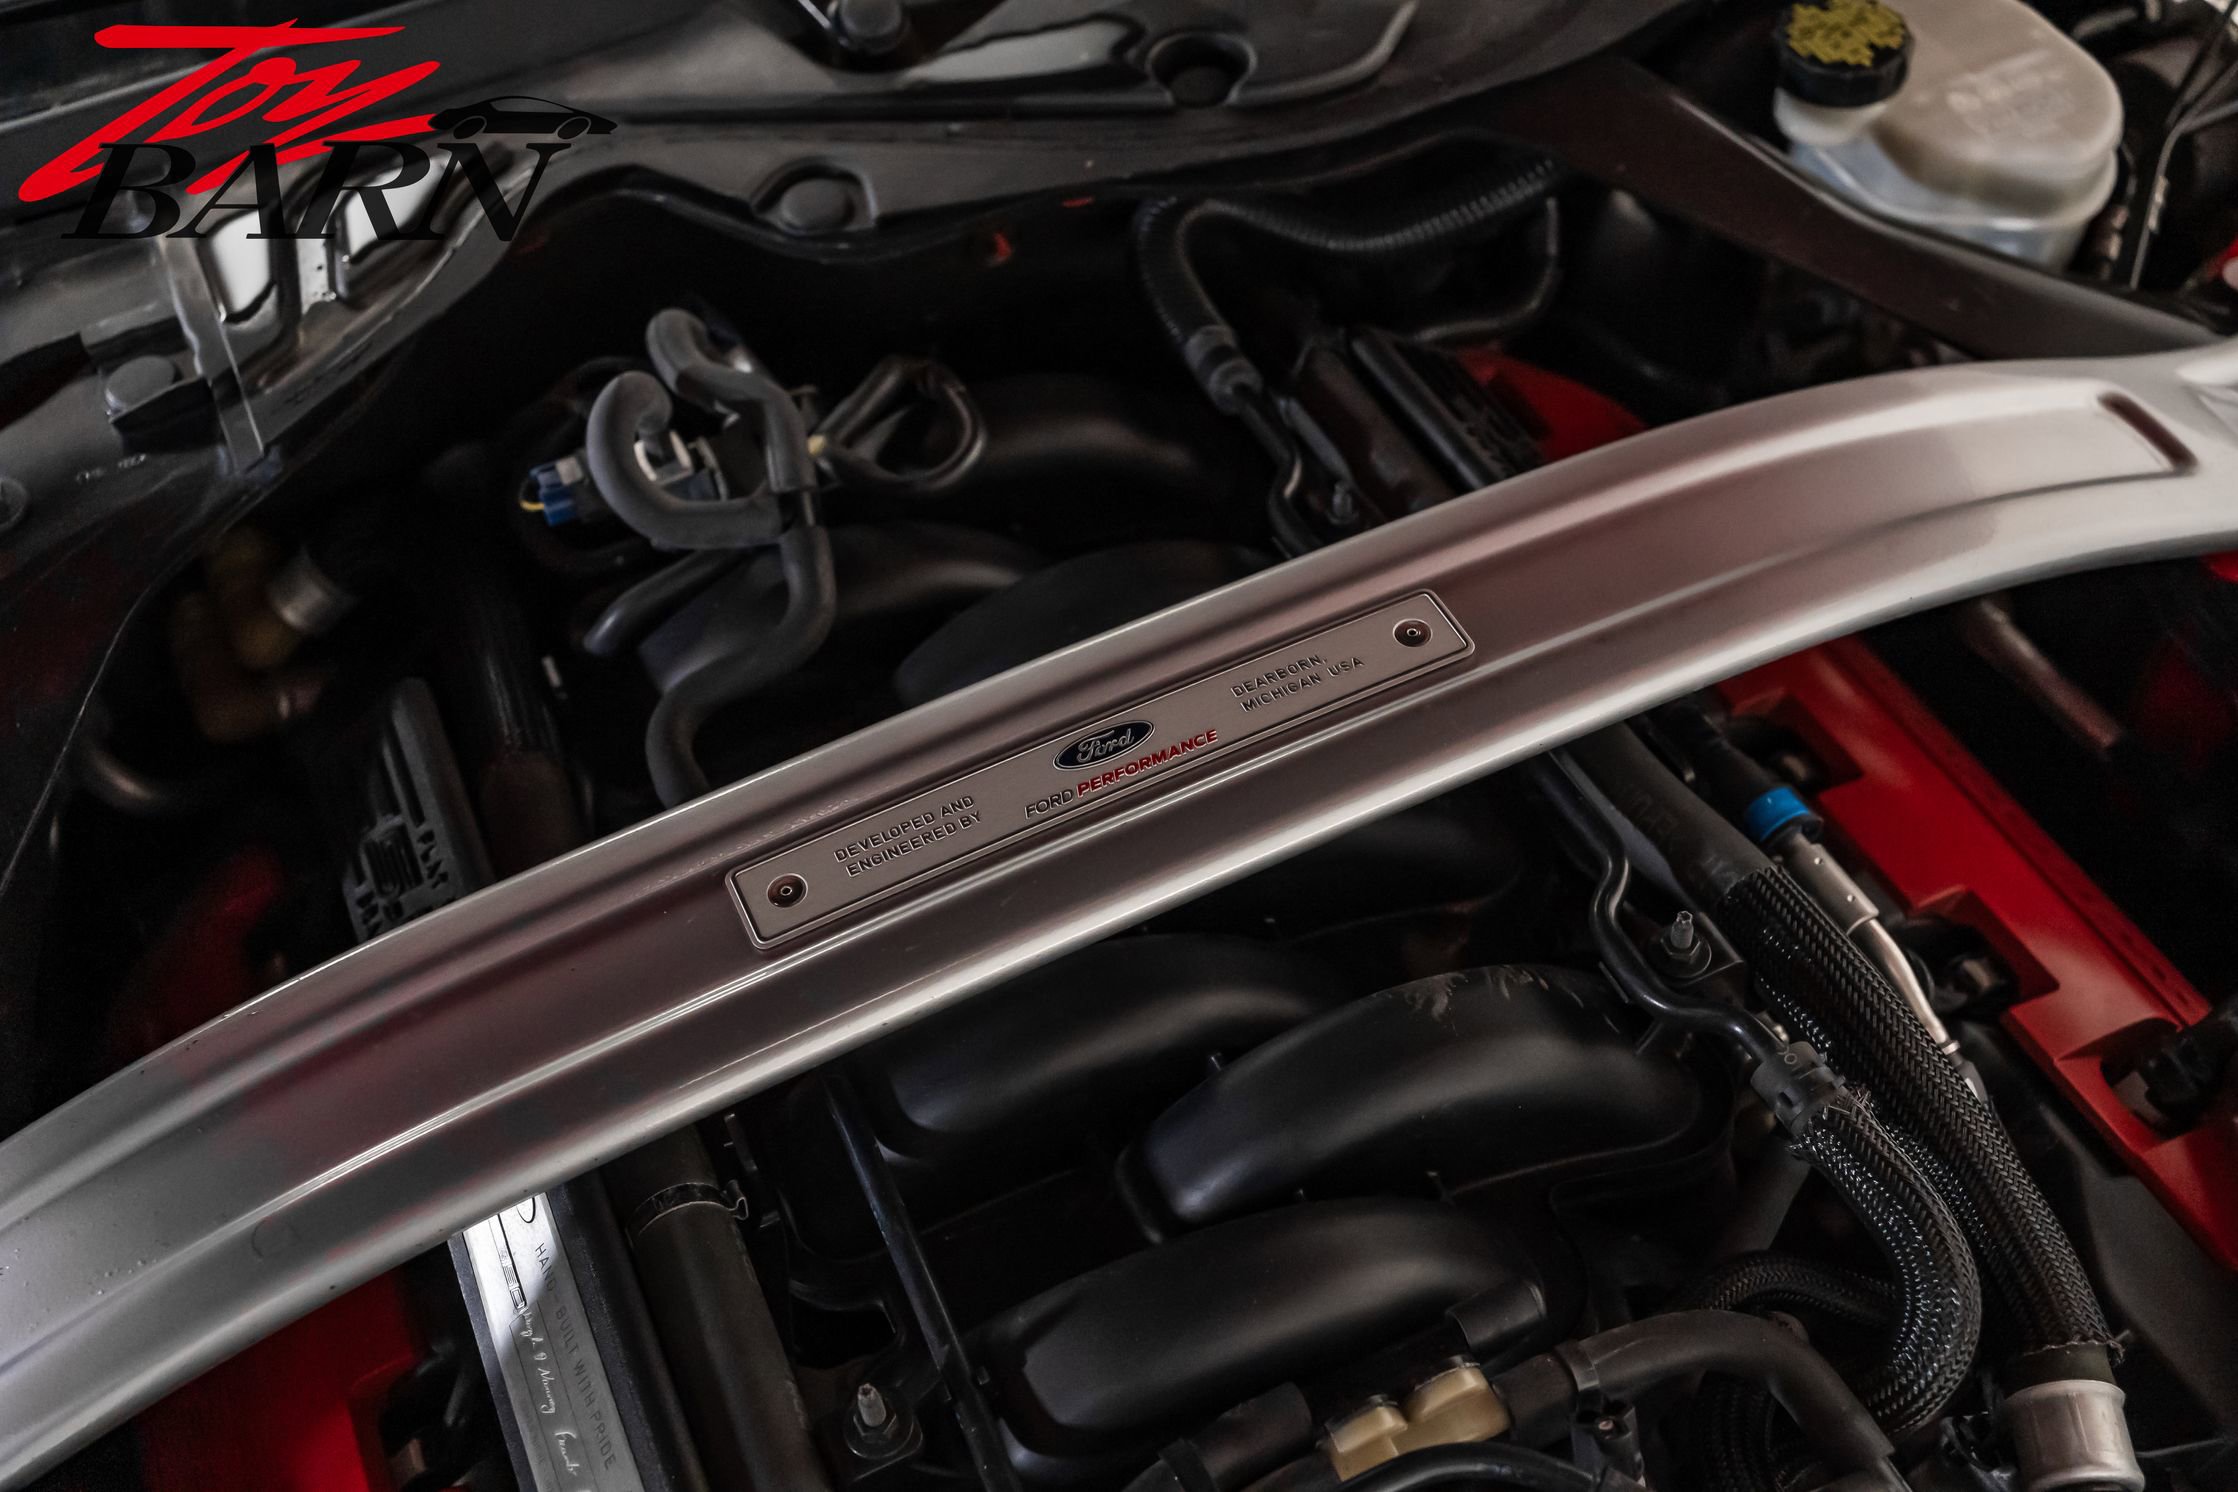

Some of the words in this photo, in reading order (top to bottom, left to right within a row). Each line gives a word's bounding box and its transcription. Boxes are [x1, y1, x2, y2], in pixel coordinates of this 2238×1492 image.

[1230, 654, 1327, 698] DEARBORN,
[1240, 672, 1323, 713] MICHIGAN
[1326, 656, 1365, 677] USA
[1024, 789, 1074, 819] FORD
[1075, 729, 1219, 798] PERFORMANCE
[1075, 728, 1135, 763] Ford
[833, 812, 935, 863] DEVELOPED
[940, 795, 975, 819] AND
[845, 822, 957, 878] ENGINEERED
[958, 810, 982, 830] BY
[574, 1359, 596, 1408] WITH
[590, 1411, 617, 1470] PRIDE
